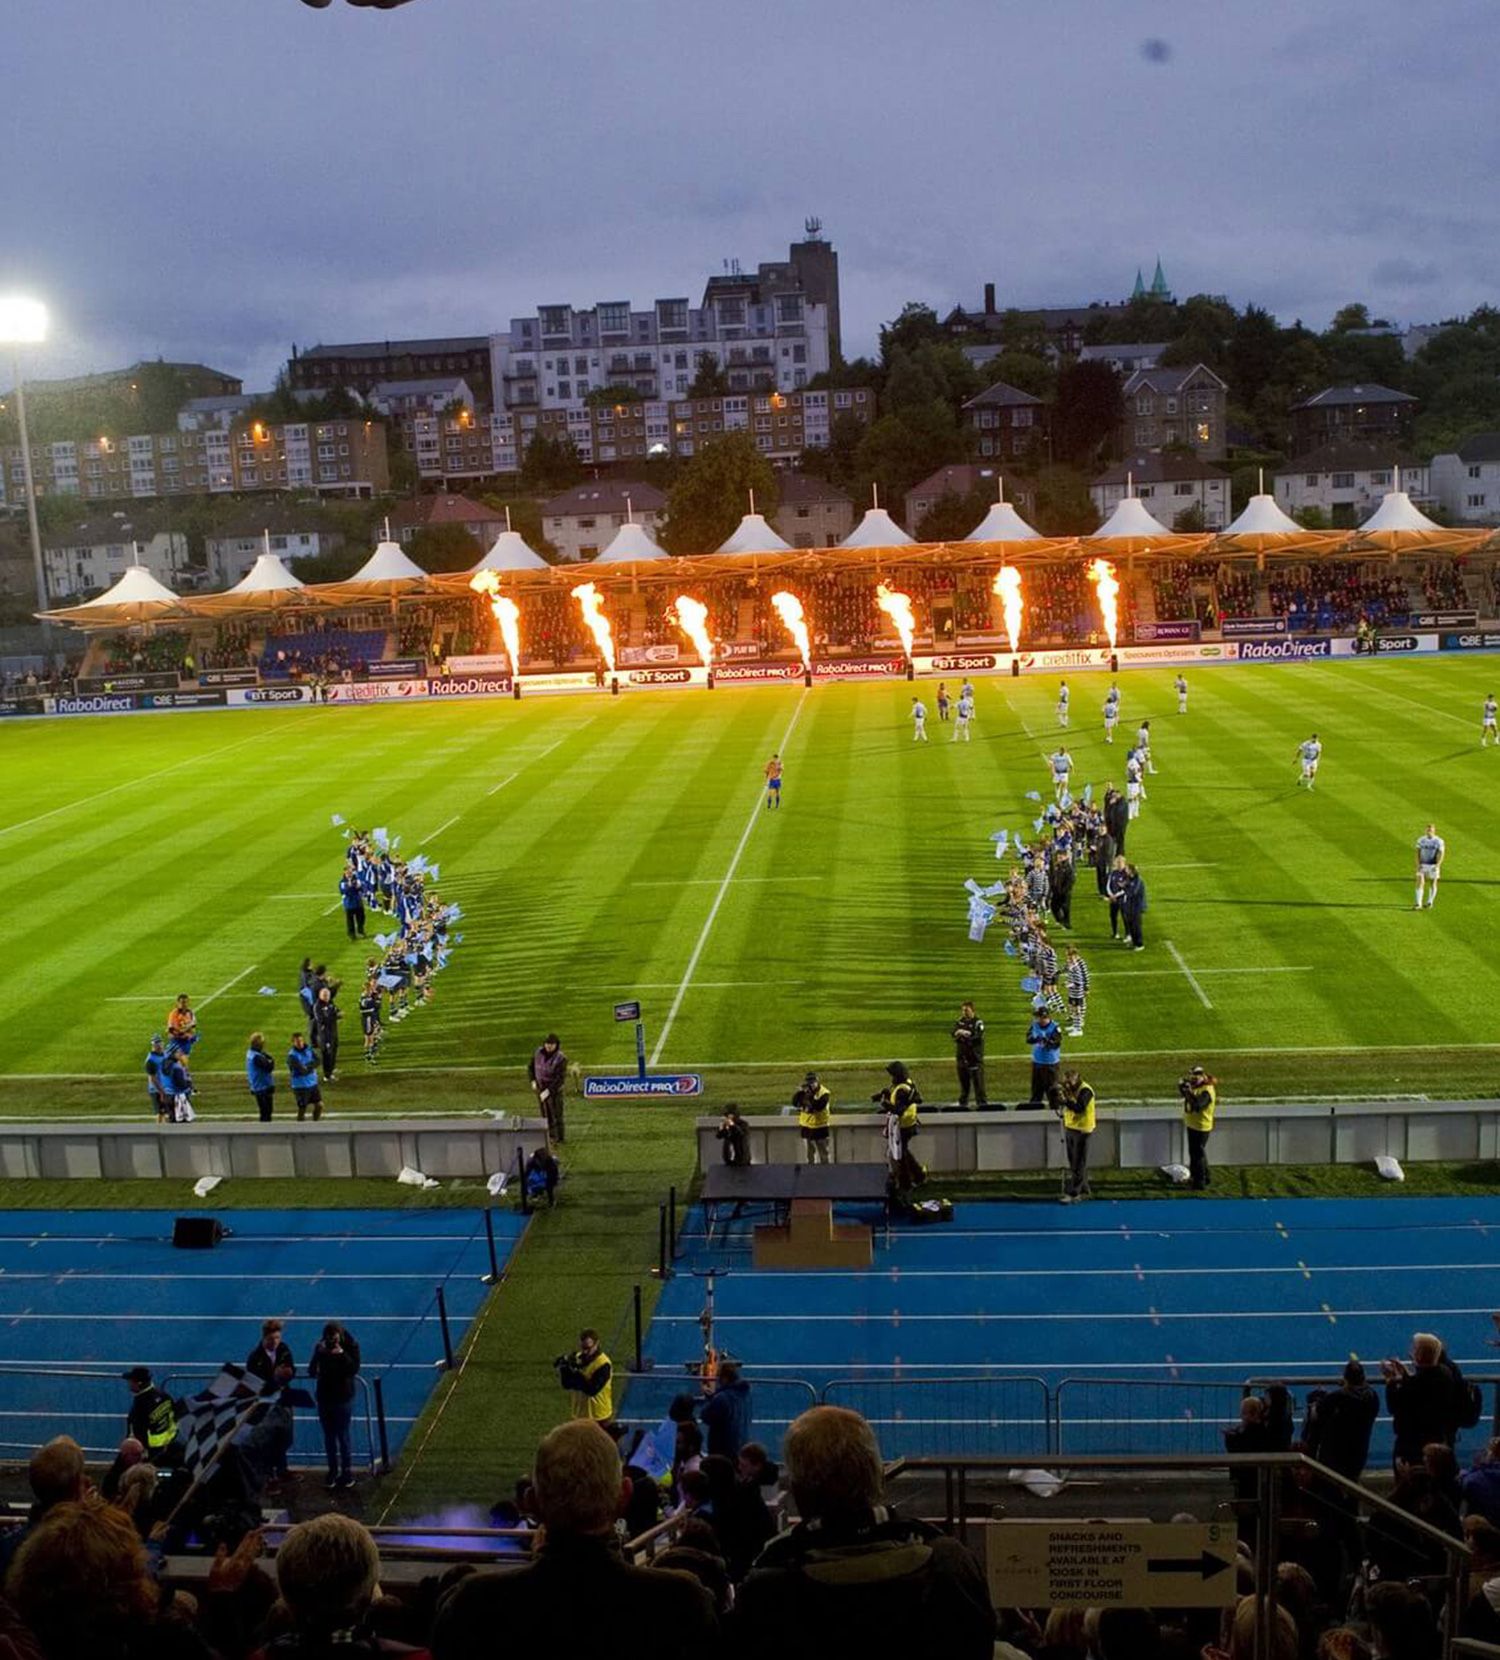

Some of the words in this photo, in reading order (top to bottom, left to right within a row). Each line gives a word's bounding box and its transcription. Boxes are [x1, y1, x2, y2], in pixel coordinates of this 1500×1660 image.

[1379, 636, 1412, 651] Sport
[1459, 635, 1482, 648] QBE
[1124, 650, 1163, 660] Specsavers
[1242, 641, 1327, 658] RaboDirect
[938, 658, 955, 669] BT
[957, 656, 990, 669] Sport
[1043, 651, 1091, 665] creditfix
[715, 666, 765, 679] RaboDirect
[816, 662, 867, 674] RaboDirect
[636, 671, 653, 682] BT
[654, 671, 685, 681] Sport
[431, 677, 508, 694] RaboDirect
[252, 692, 267, 701] BT
[269, 689, 298, 701] Sport
[59, 697, 131, 713] RaboDirect
[588, 1081, 649, 1094] RaboDirect
[1049, 1533, 1096, 1542] SNACKS
[1098, 1533, 1123, 1542] AND
[1049, 1544, 1141, 1553] REFRESHMENTS
[1049, 1556, 1112, 1565] AVAILABLE
[1112, 1556, 1126, 1564] AT
[1049, 1568, 1084, 1577] KIOSK
[1087, 1568, 1099, 1576] IN
[1049, 1579, 1081, 1588] FIRST
[1084, 1579, 1123, 1588] FLOOR
[1049, 1591, 1123, 1600] CONCOURSE
